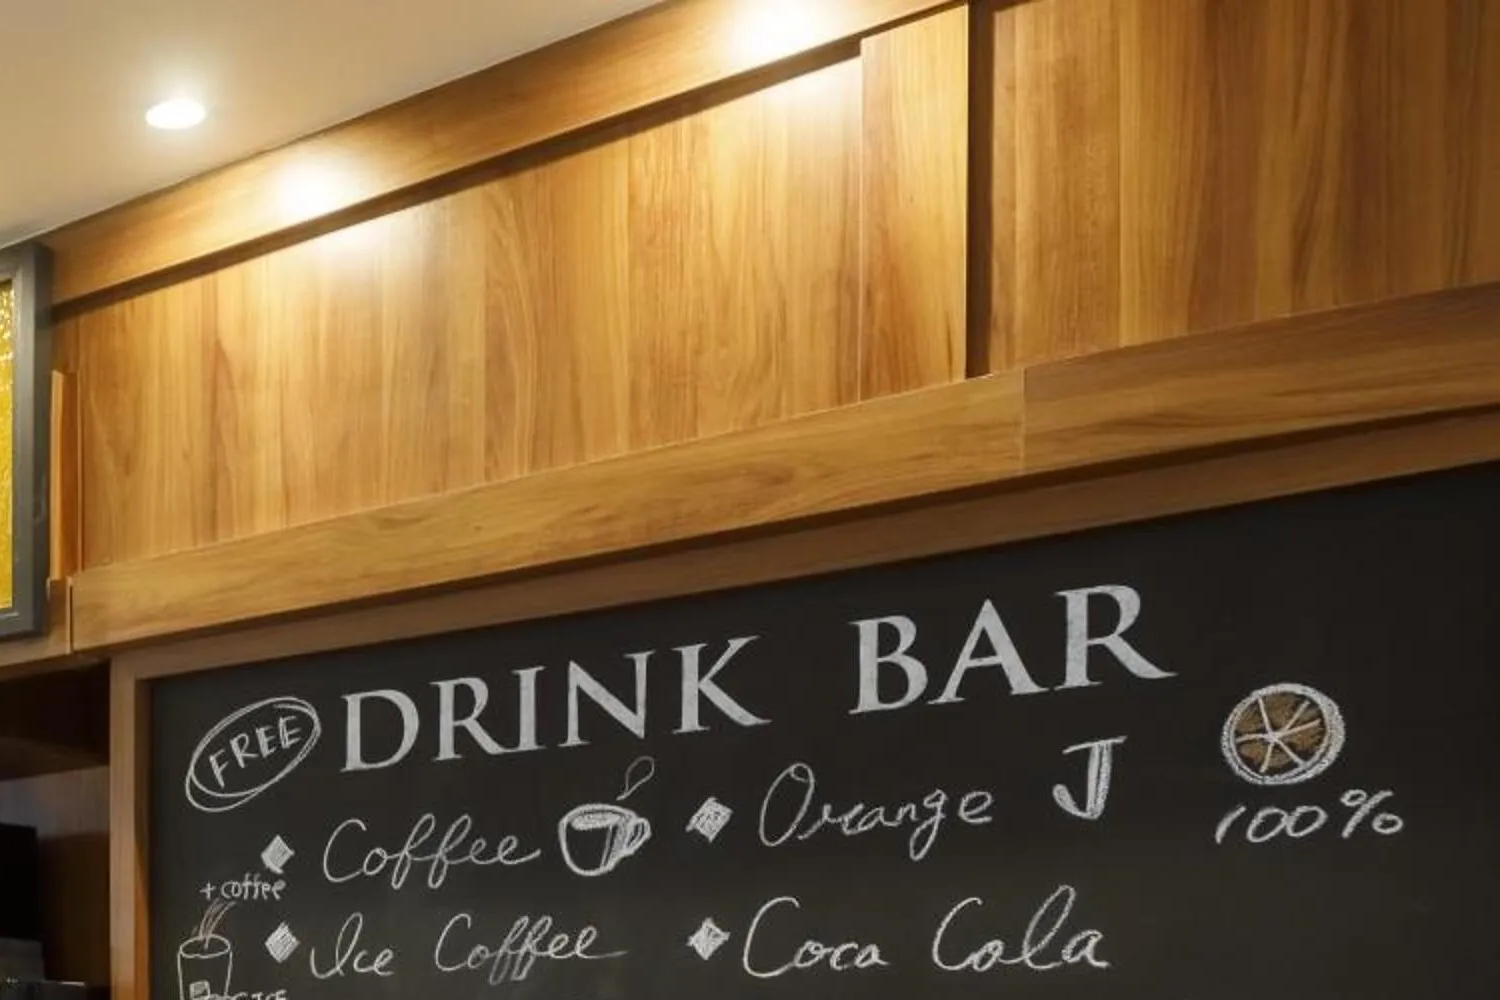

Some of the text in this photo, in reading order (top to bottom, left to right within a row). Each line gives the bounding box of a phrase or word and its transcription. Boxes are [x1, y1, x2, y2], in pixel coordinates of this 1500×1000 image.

[339, 583, 1178, 773] DRINK BAR
[208, 714, 301, 788] FREE
[758, 735, 1128, 862] Orange J
[1214, 788, 1405, 845] 100%
[322, 812, 542, 891] Coffee
[309, 911, 628, 986] Ice Coffee
[741, 884, 1111, 979] Coca Cola
